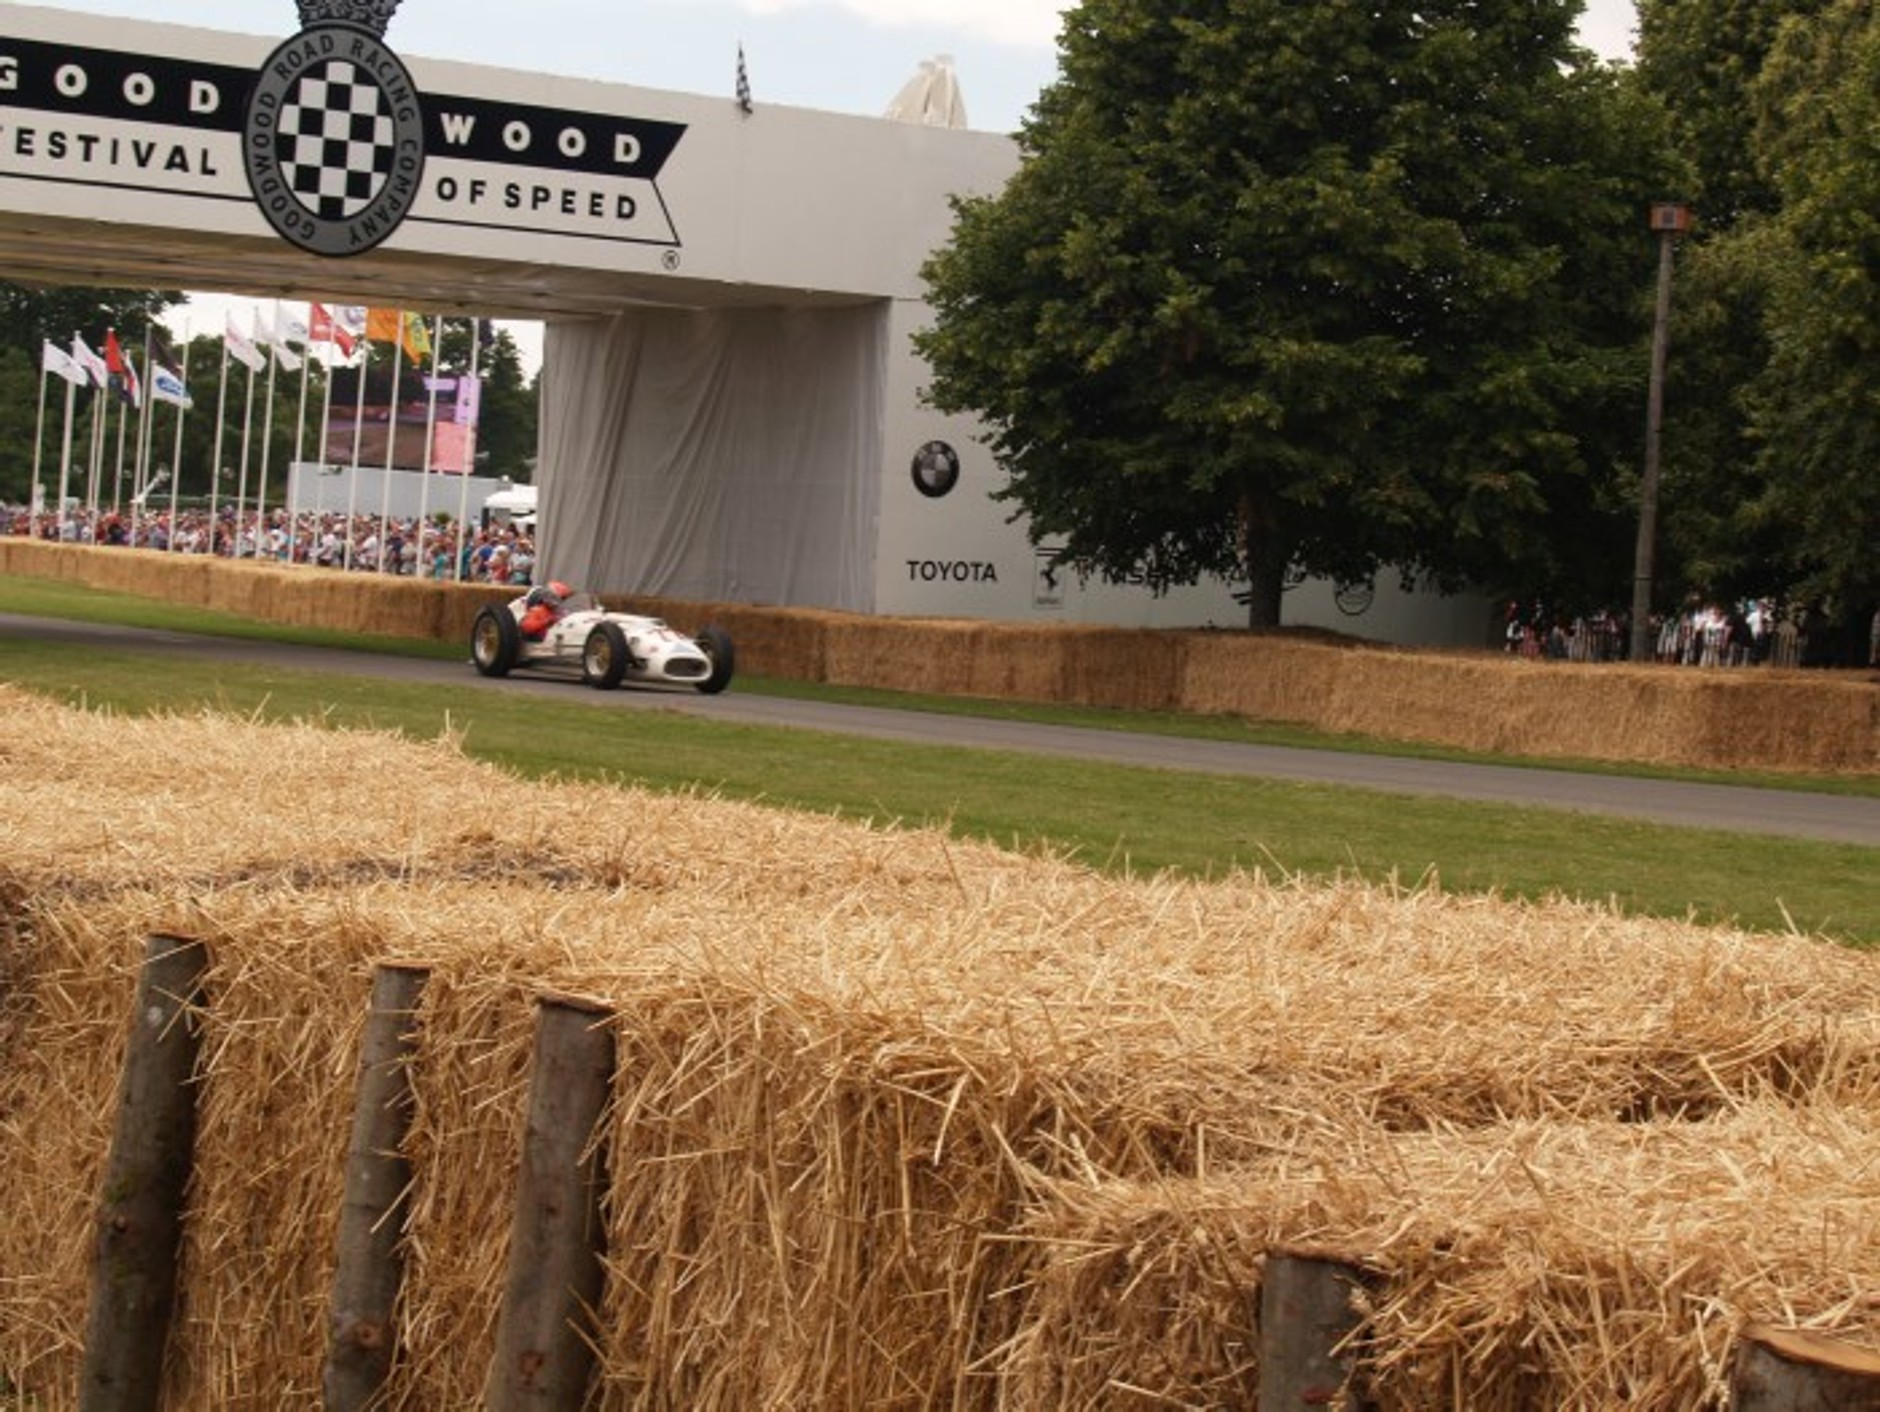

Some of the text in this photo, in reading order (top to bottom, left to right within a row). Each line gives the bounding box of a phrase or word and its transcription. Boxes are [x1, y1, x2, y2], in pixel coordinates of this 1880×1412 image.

[0, 125, 637, 220] ESTIVAL OF SPEED
[252, 34, 418, 247] GOODWOOD ROAD RACING COMPANY
[440, 112, 641, 163] WOOD
[906, 560, 998, 582] TOYOTA
